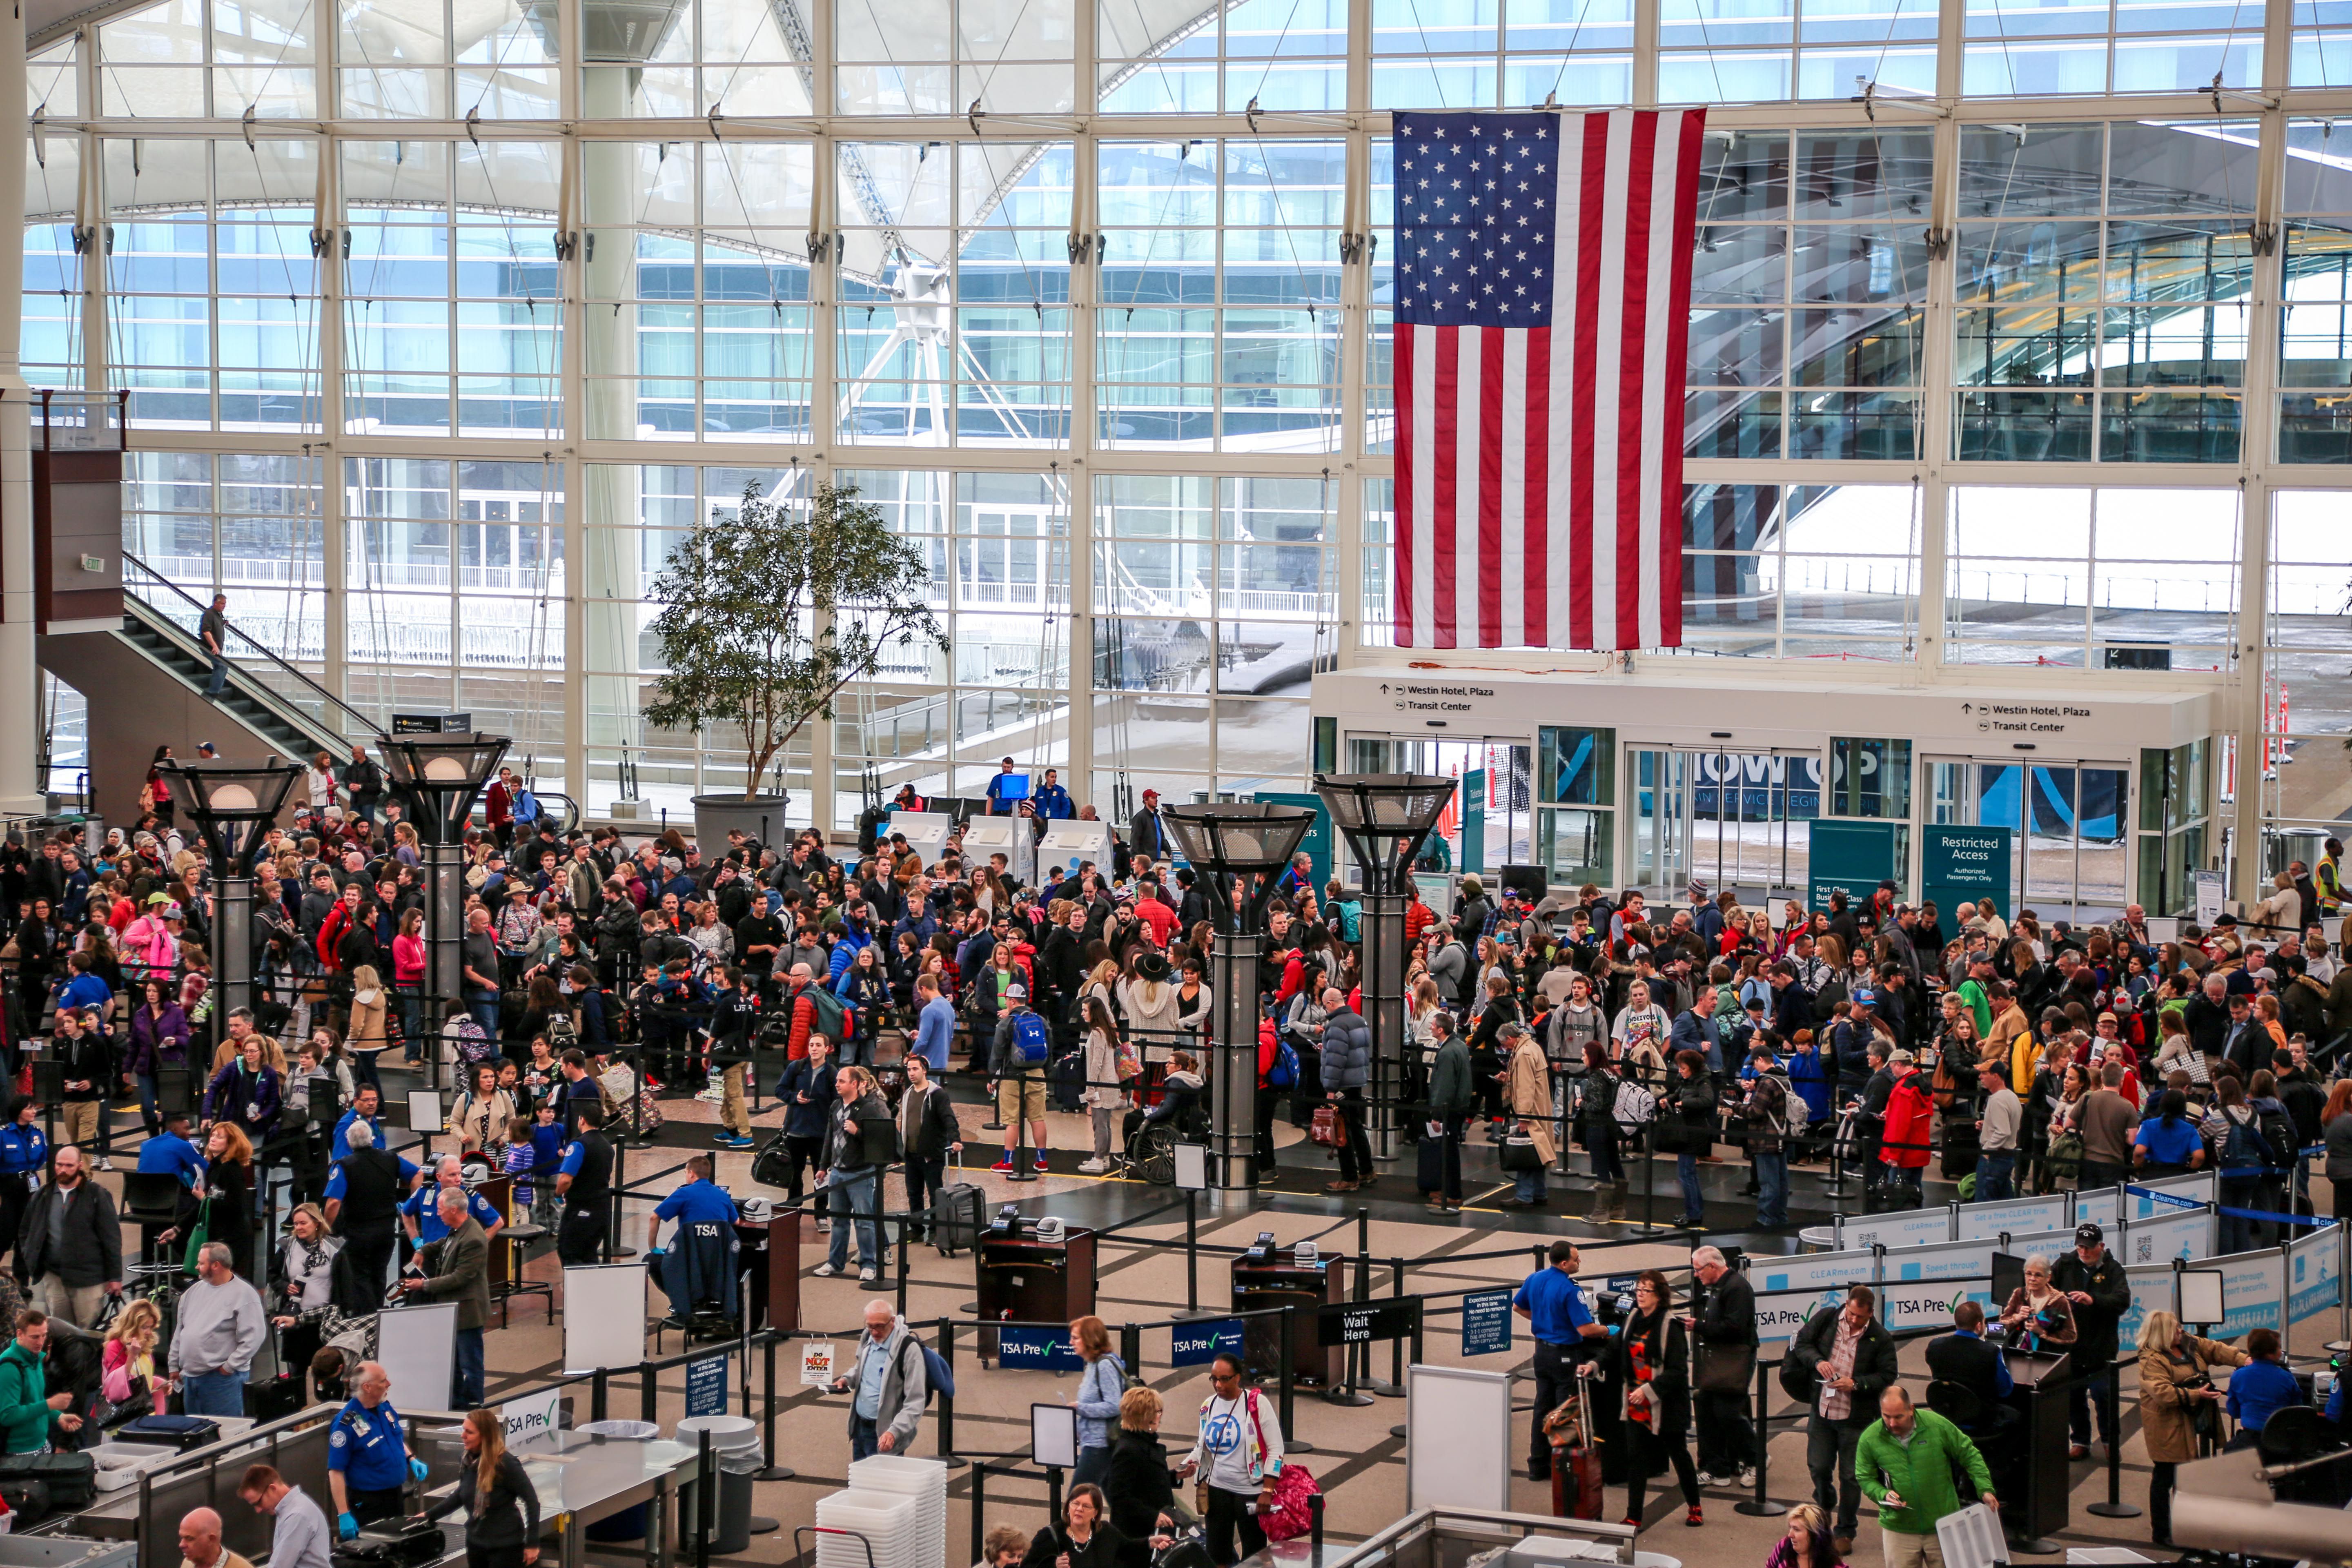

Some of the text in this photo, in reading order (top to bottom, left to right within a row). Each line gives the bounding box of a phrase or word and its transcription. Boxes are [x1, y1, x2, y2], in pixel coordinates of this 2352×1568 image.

[1441, 687, 1467, 696] Hotel,
[1408, 701, 1438, 710] Transit
[1993, 706, 2090, 716] Westin Hotel, Plaza
[1993, 722, 2065, 731] Transit Center
[1470, 787, 1483, 799] Ticketed
[1468, 802, 1484, 812] Passengers
[1839, 798, 1878, 811] ARIL
[1942, 837, 1998, 849] Restricted
[1952, 849, 1988, 860] Access
[1020, 860, 1033, 870] CLEAR
[2155, 1194, 2193, 1208] clearme.com
[2009, 1208, 2031, 1218] CLEAR
[695, 1225, 717, 1236] TSA
[1904, 1221, 1946, 1231] CLEARme.com
[1925, 1261, 1979, 1273] Speed through
[1811, 1267, 1866, 1279] CLEARme.com
[2223, 1272, 2264, 1285] peed through
[2127, 1278, 2168, 1287] ARme.com
[2224, 1287, 2239, 1296] rport
[1896, 1299, 1944, 1314] TSA Pre
[1344, 1316, 1368, 1328] Wait
[1755, 1310, 1799, 1325] TSA Pre
[1344, 1330, 1370, 1341] Here
[1002, 1343, 1040, 1355] TSA Pre
[1174, 1340, 1207, 1352] TSA Pre
[708, 1355, 724, 1363] screening
[805, 1357, 830, 1366] NOT
[702, 1382, 719, 1392] outerwear
[702, 1390, 718, 1399] compliant
[701, 1402, 716, 1410] carry-on
[526, 1414, 542, 1429] Pre
